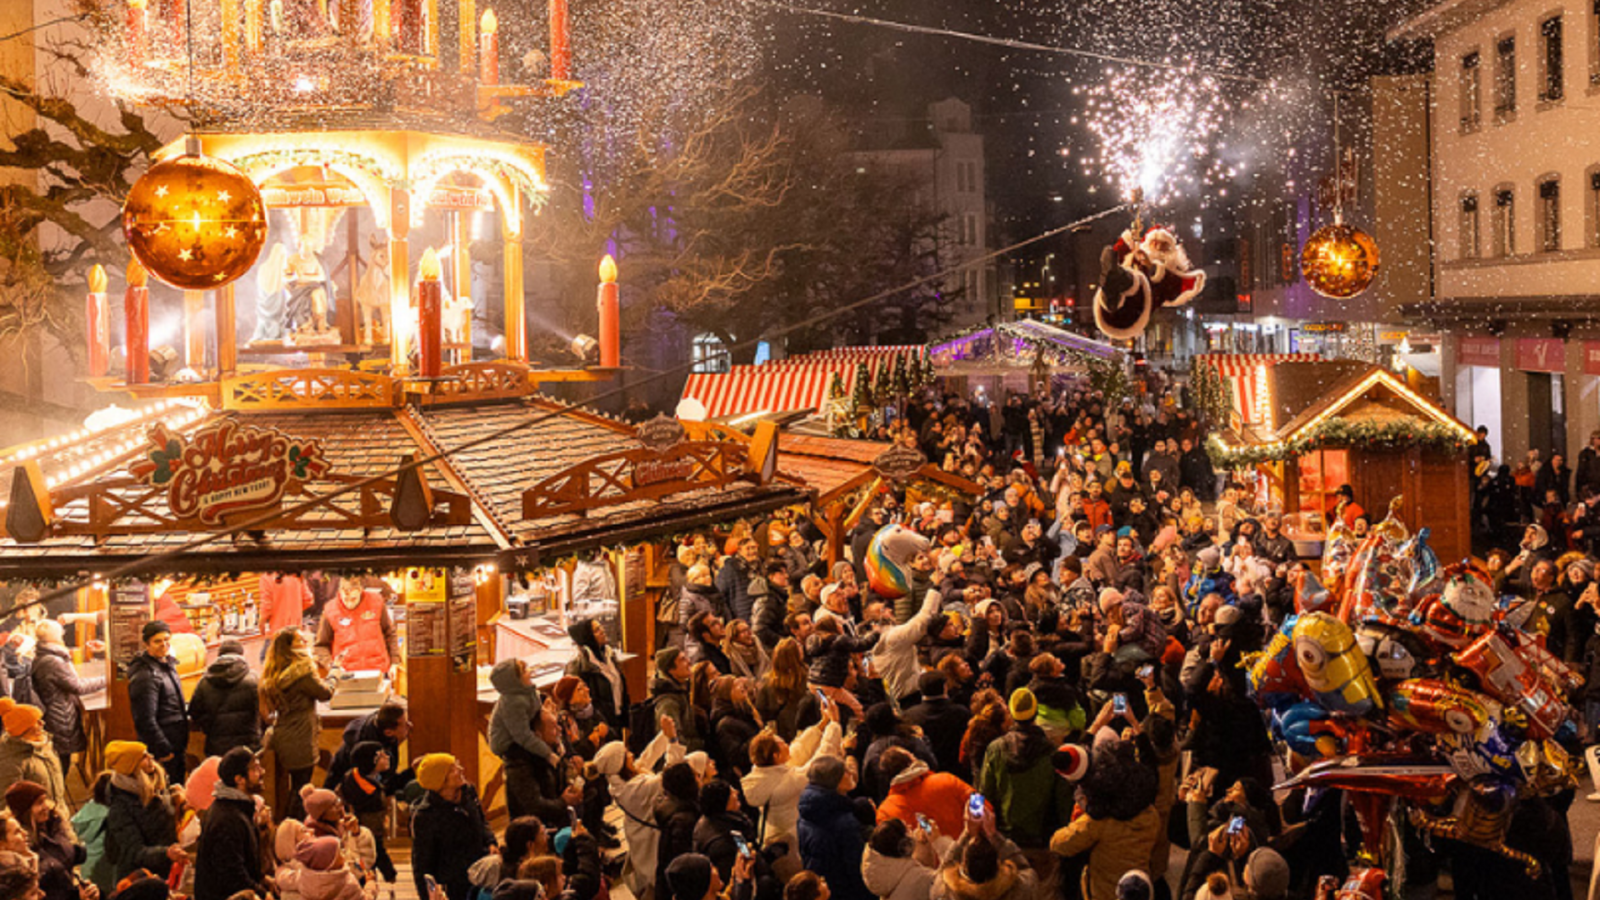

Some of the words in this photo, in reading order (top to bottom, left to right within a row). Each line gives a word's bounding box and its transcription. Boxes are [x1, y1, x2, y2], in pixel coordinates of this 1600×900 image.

[184, 421, 287, 470] Merry
[170, 458, 287, 514] Christmas
[233, 485, 248, 497] NEW
